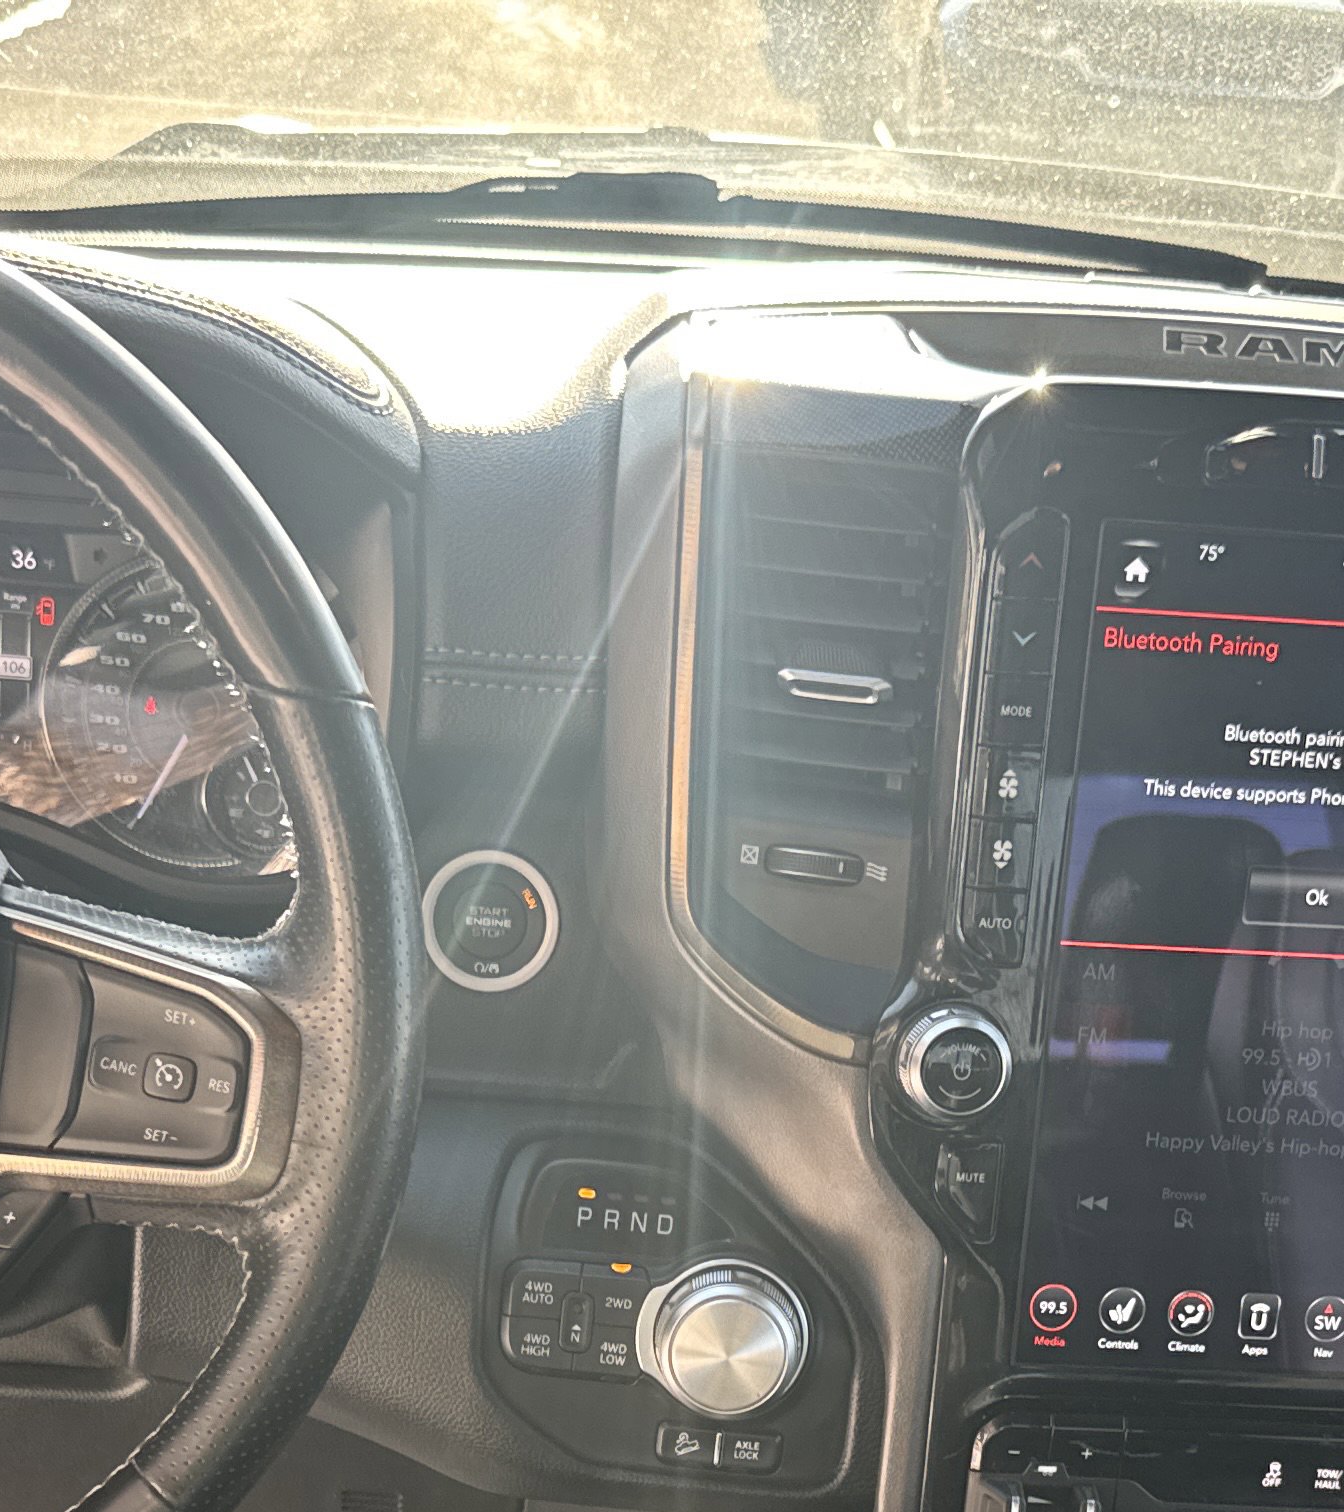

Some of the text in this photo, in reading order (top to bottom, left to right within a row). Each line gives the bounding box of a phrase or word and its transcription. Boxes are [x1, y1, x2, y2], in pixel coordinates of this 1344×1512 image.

[11, 550, 37, 570] 36
[1199, 544, 1225, 562] 75°
[142, 613, 171, 626] 70
[116, 631, 147, 644] 60
[1104, 626, 1280, 663] Bluetooth Pairing
[2, 660, 27, 675] 106
[1000, 704, 1033, 718] MODE
[1224, 723, 1302, 746] Bluetooth
[1249, 748, 1342, 771] STEPHEN's
[1144, 778, 1176, 798] This
[1180, 779, 1233, 801] device
[1236, 786, 1307, 806] supports
[1305, 887, 1330, 907] Ok
[465, 916, 512, 928] ENGINE
[979, 917, 1012, 930] AUTO
[1083, 962, 1116, 981] AM
[1077, 1026, 1108, 1046] FM
[1262, 1020, 1334, 1042] Hip hop
[945, 1043, 982, 1056] VOLUME
[1242, 1048, 1281, 1067] 99.5
[100, 1057, 138, 1078] CANC
[208, 1078, 232, 1095] RES
[1262, 1079, 1318, 1098] WBUS
[1226, 1106, 1280, 1126] LOUD
[1145, 1131, 1204, 1154] Happy
[1210, 1133, 1275, 1157] Valley's
[956, 1172, 986, 1184] MUTE
[1162, 1187, 1207, 1202] Browse
[1260, 1192, 1291, 1205] Tune
[576, 1206, 674, 1235] P R N D
[525, 1280, 553, 1294] 4WD
[522, 1292, 554, 1305] AUTO
[605, 1297, 632, 1310] 2WD
[1039, 1300, 1068, 1316] 99.5
[1313, 1314, 1342, 1332] SW
[523, 1333, 551, 1346] 4WD
[570, 1331, 581, 1343] N
[1033, 1334, 1066, 1349] Media
[1097, 1337, 1140, 1352] Controls
[520, 1344, 551, 1357] HIGH
[600, 1342, 627, 1355] 4WD
[1167, 1340, 1206, 1355] Climate
[1241, 1344, 1269, 1358] Apps
[1313, 1347, 1334, 1360] Nav
[599, 1353, 626, 1366] LOW
[735, 1440, 760, 1451] AXLE
[733, 1449, 759, 1460] LOCK
[1262, 1477, 1282, 1488] OFF
[1314, 1479, 1341, 1490] HAUL
